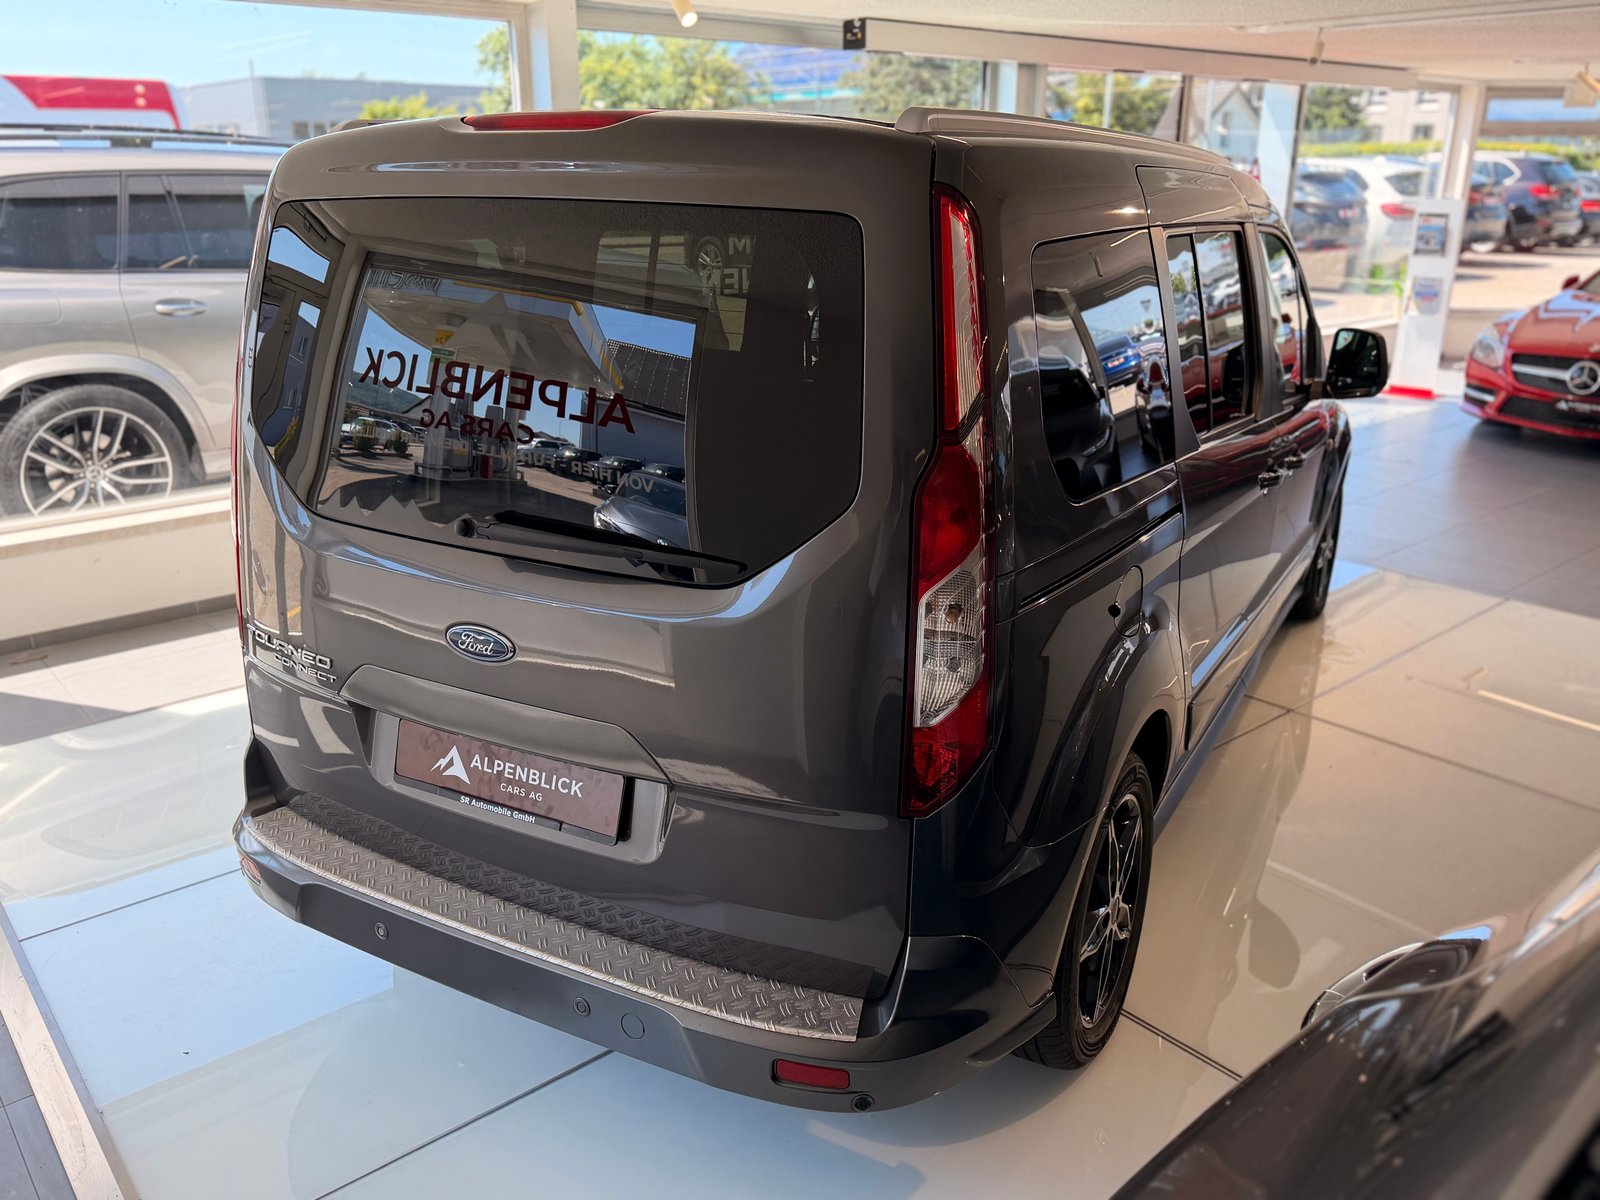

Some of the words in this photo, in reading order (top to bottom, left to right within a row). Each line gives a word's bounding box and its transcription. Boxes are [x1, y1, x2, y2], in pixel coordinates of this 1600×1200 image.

[246, 623, 333, 670] TOURNEO
[458, 631, 494, 656] Ford
[273, 652, 338, 683] CONNECT
[470, 753, 584, 798] ALPENBLICK
[500, 782, 526, 797] CARS
[529, 791, 543, 802] AG
[459, 795, 470, 805] SR
[470, 799, 512, 818] Automobile
[513, 811, 536, 824] GmbH
